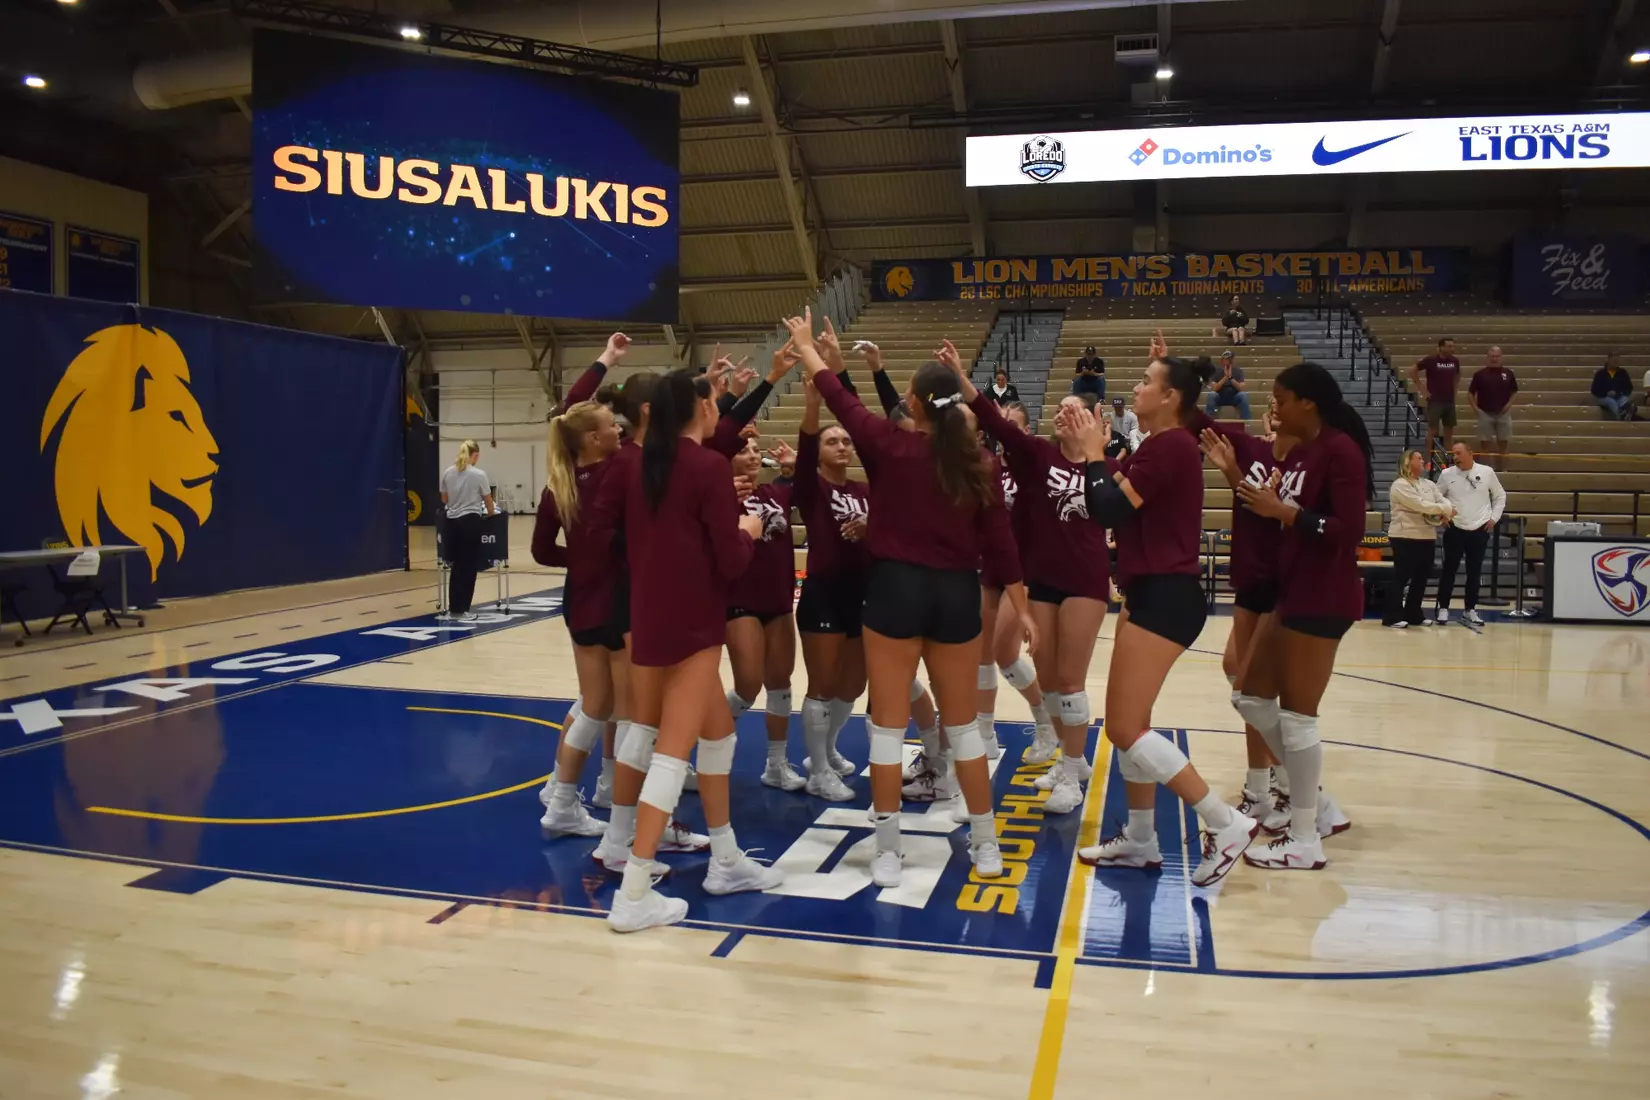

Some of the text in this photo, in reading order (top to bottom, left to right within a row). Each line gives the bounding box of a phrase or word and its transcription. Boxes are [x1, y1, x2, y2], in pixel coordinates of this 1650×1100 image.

[1459, 123, 1610, 136] EAST TEXAS A&M
[1022, 150, 1063, 164] LOREDO
[1163, 144, 1273, 166] Domino's
[1459, 133, 1611, 161] LIONS
[273, 145, 669, 227] SIUSALUKIS
[952, 251, 1435, 284] LION MEN'S BASKETBALL
[1540, 243, 1606, 276] Fix &
[979, 285, 1000, 299] LSC
[1121, 282, 1129, 296] 7
[1132, 282, 1167, 296] NCAA
[1170, 280, 1265, 295] TOURNAMENTS
[1296, 278, 1312, 293] 30
[1318, 276, 1425, 293] LL-AMERICANS
[1551, 267, 1611, 296] Feed
[1360, 536, 1390, 544] IONS
